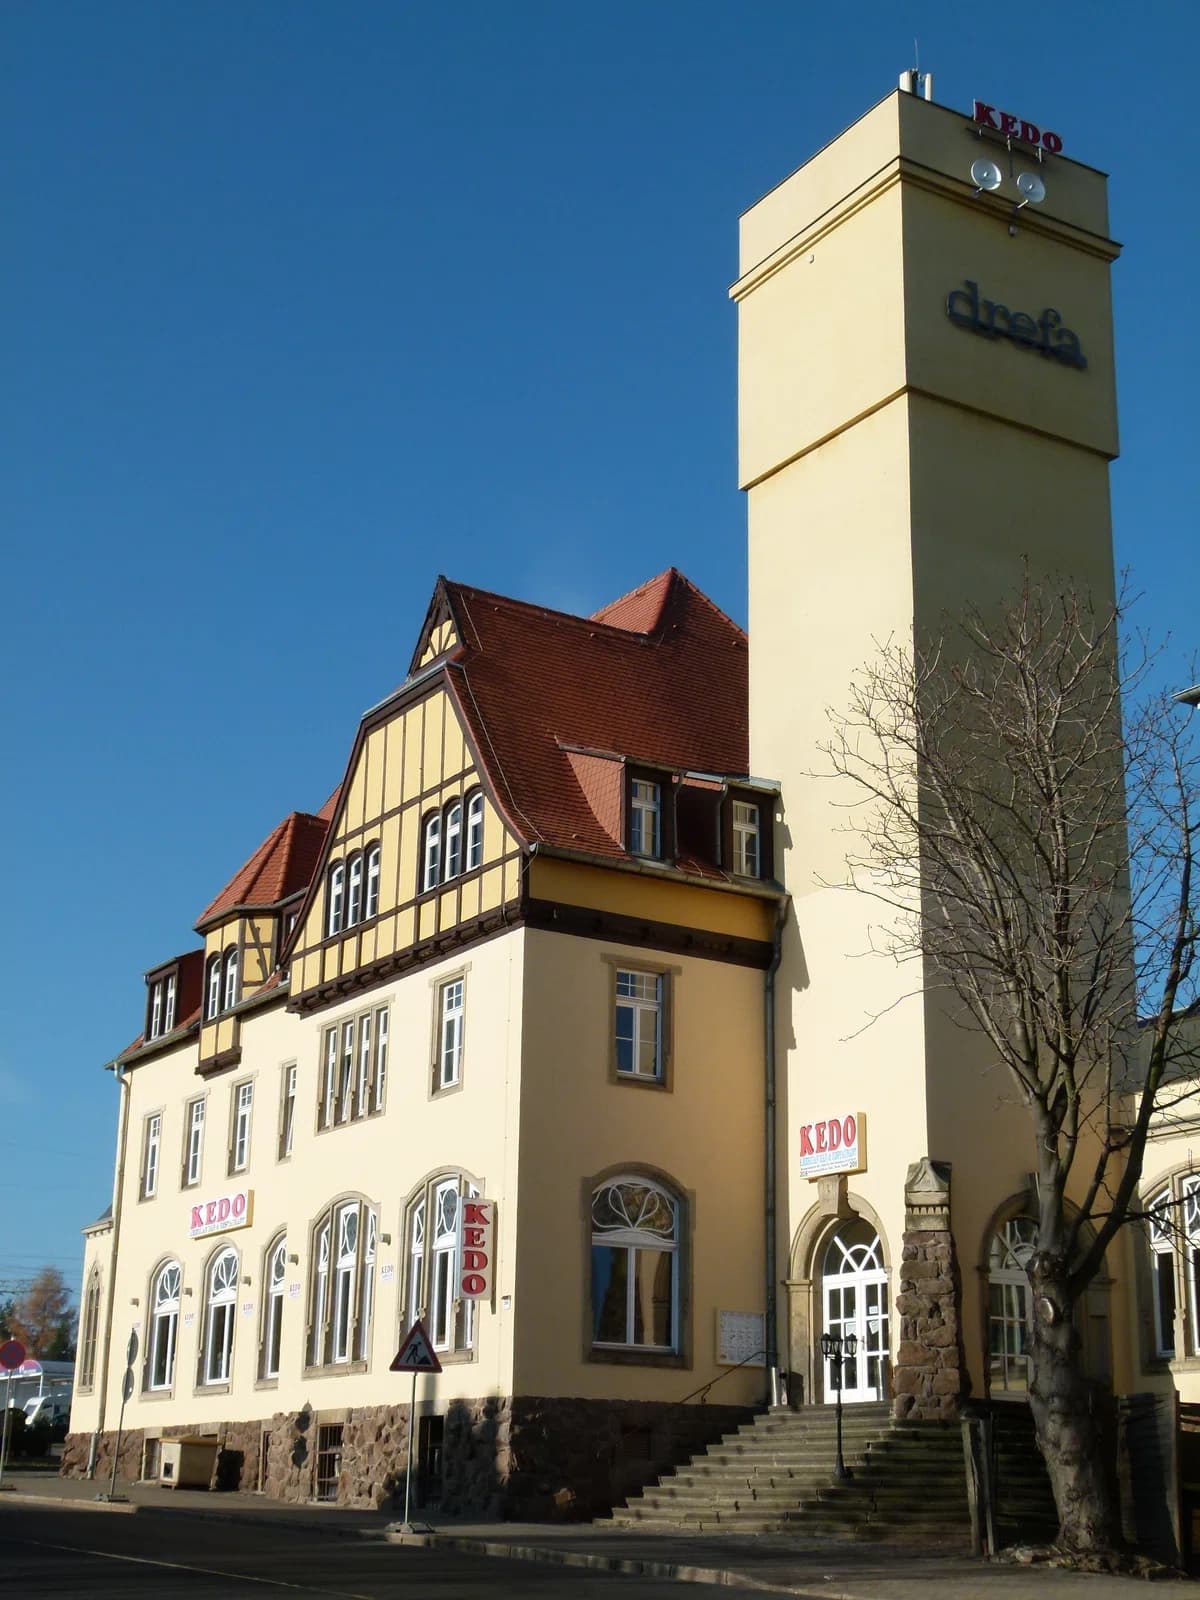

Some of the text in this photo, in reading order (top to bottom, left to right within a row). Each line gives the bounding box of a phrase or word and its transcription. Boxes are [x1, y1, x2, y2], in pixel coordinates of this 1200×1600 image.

[975, 101, 1063, 152] KEDO
[946, 279, 1087, 368] drefa
[800, 1115, 856, 1157] KEDO
[191, 1193, 246, 1230] KEDO
[462, 1203, 490, 1295] KEDO
